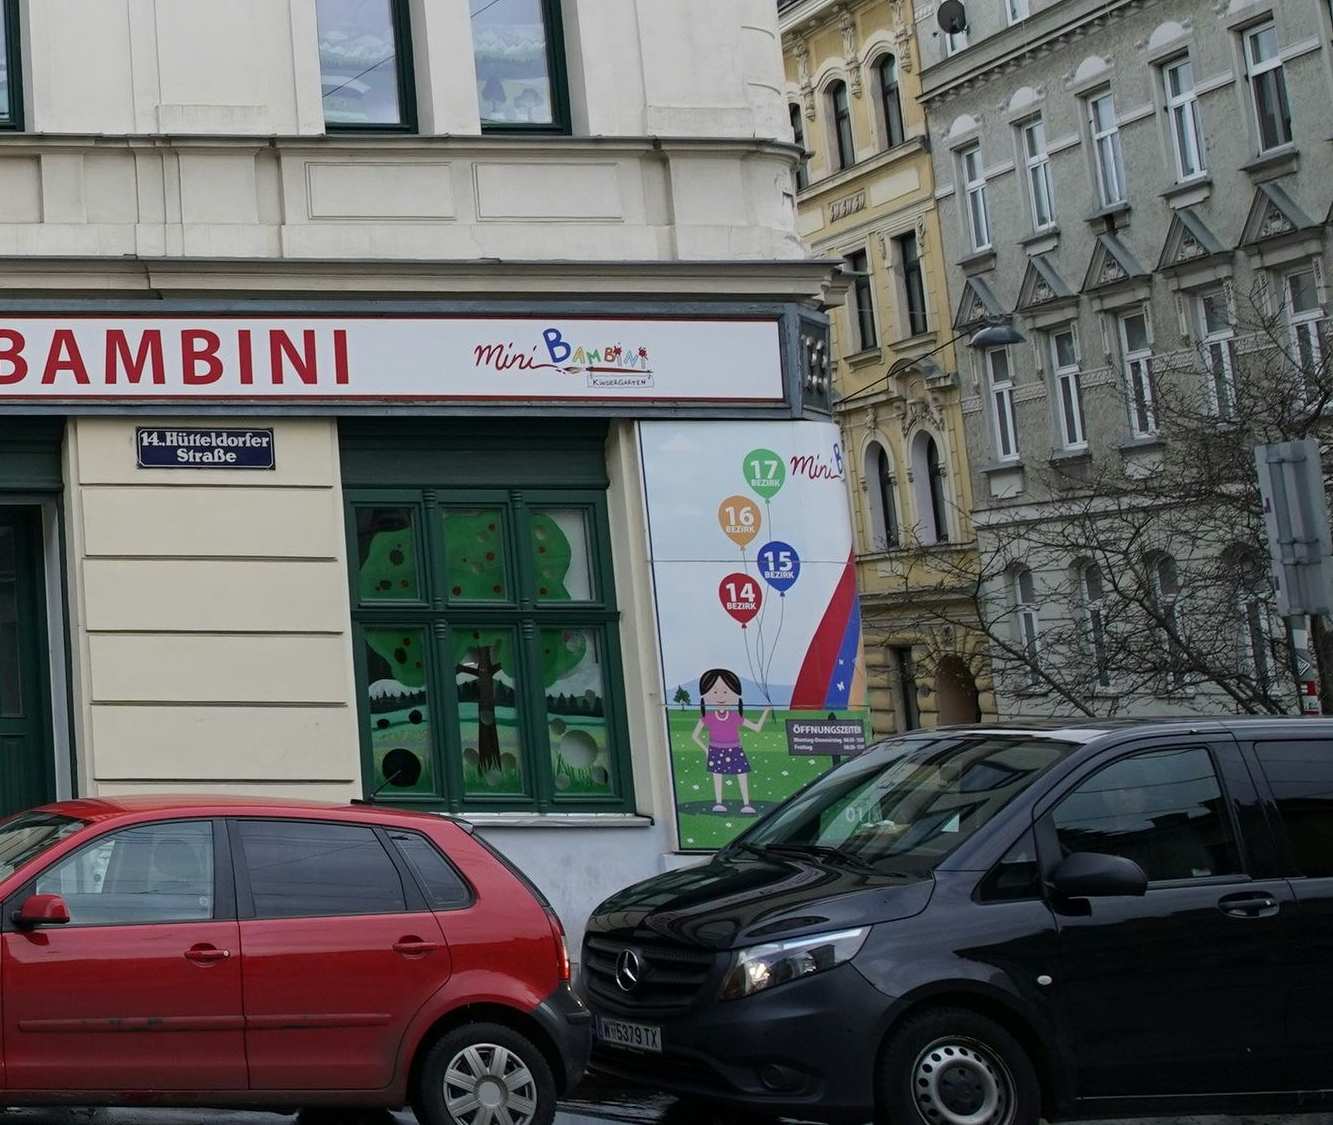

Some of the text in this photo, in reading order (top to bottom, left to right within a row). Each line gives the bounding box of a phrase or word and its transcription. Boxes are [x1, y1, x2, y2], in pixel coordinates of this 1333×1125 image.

[177, 448, 237, 463] Straße
[750, 460, 778, 479] 17
[750, 479, 780, 487] BEZIRK
[725, 506, 754, 526] 16
[725, 525, 755, 533] BEZIRK
[763, 551, 793, 571] 15
[764, 571, 794, 579] BEZIRK
[726, 583, 755, 602] 14
[726, 602, 757, 610] BEZIRK
